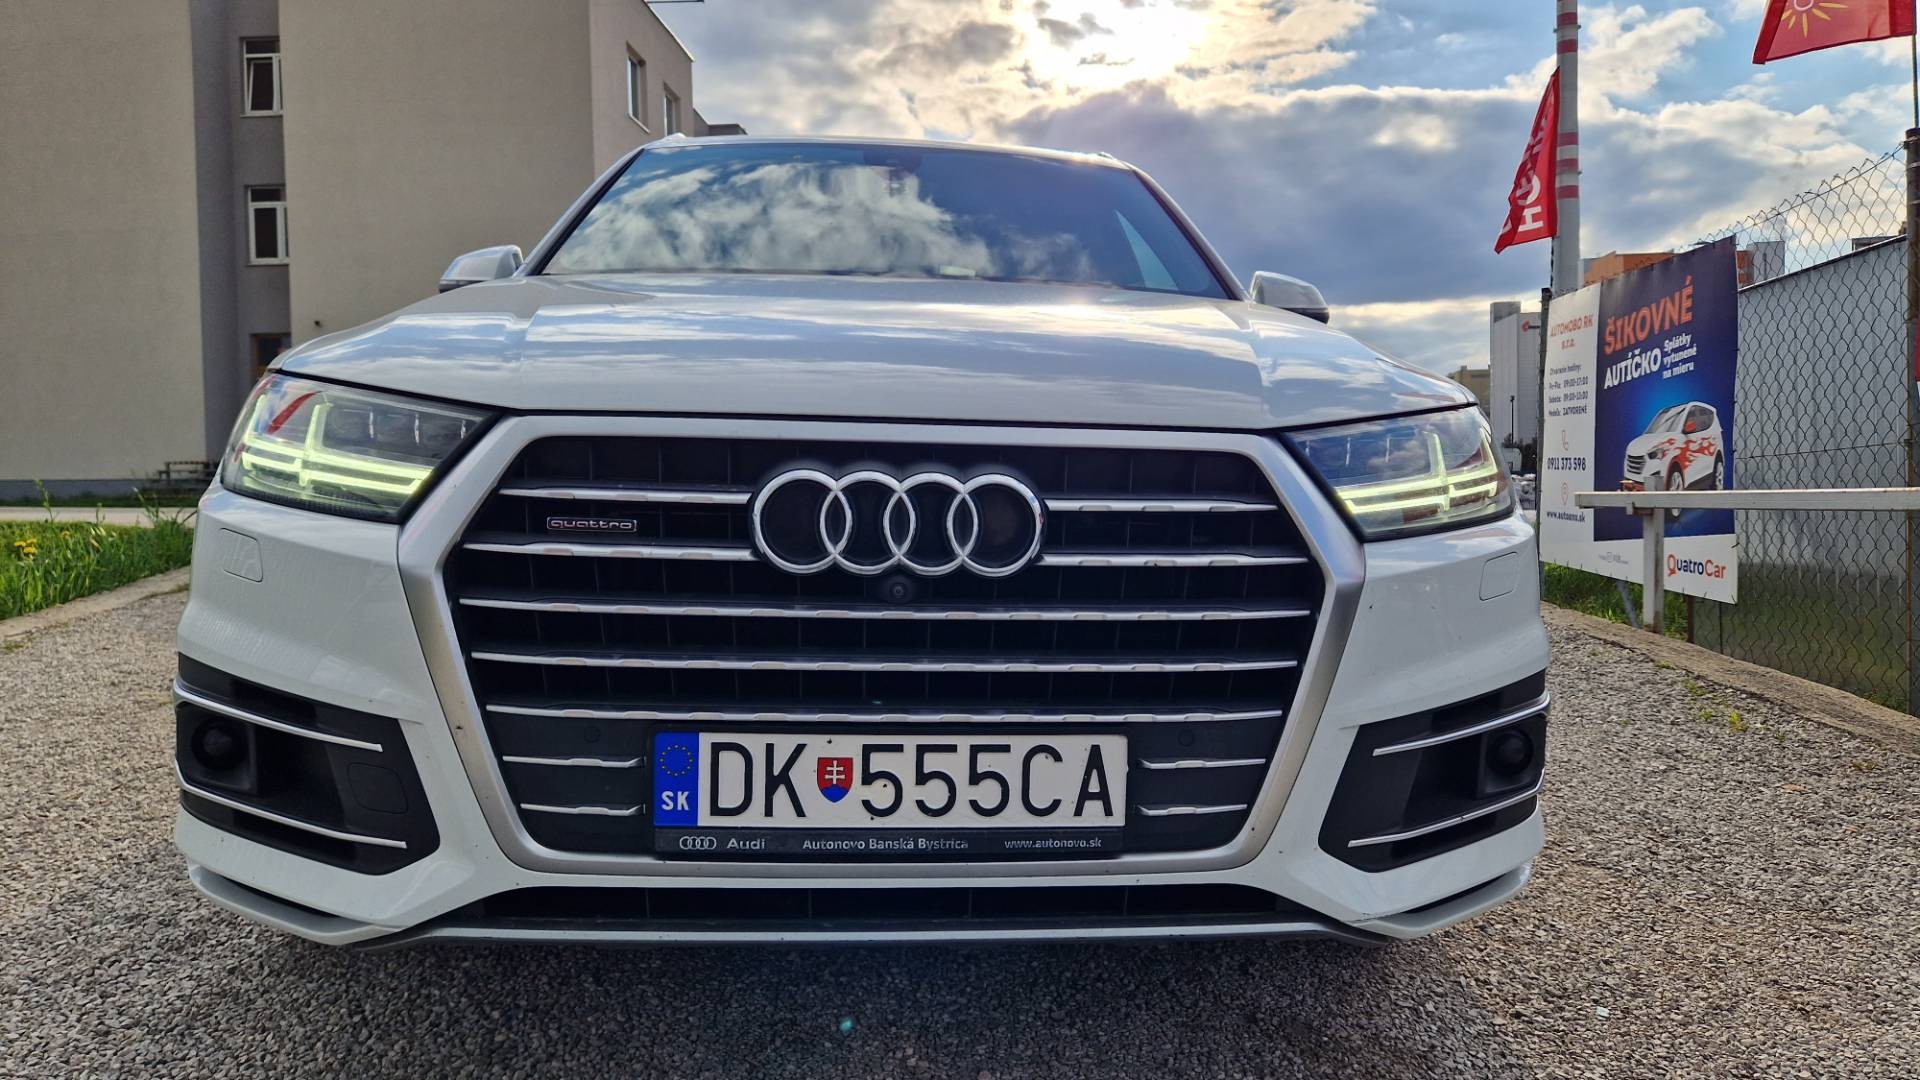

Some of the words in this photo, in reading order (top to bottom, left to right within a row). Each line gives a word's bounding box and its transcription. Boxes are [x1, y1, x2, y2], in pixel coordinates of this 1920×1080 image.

[1605, 275, 1693, 355] ŠIKOVNÉ
[1664, 332, 1692, 353] Splátky
[1604, 348, 1661, 389] AUTÍČKO
[1672, 361, 1694, 375] mieru
[1547, 457, 1560, 470] 0911
[1561, 457, 1572, 471] 373
[1573, 458, 1586, 471] 598
[550, 519, 632, 529] quattro
[1667, 554, 1726, 579] QuatroCar
[661, 790, 690, 811] SK
[709, 742, 808, 817] DK
[861, 743, 1114, 818] 555CA
[726, 837, 765, 850] Audi
[803, 838, 866, 850] Autonovo
[868, 837, 915, 850] Banská
[918, 837, 968, 851] Bystrica
[1004, 837, 1102, 849] www.autonovo.sk
